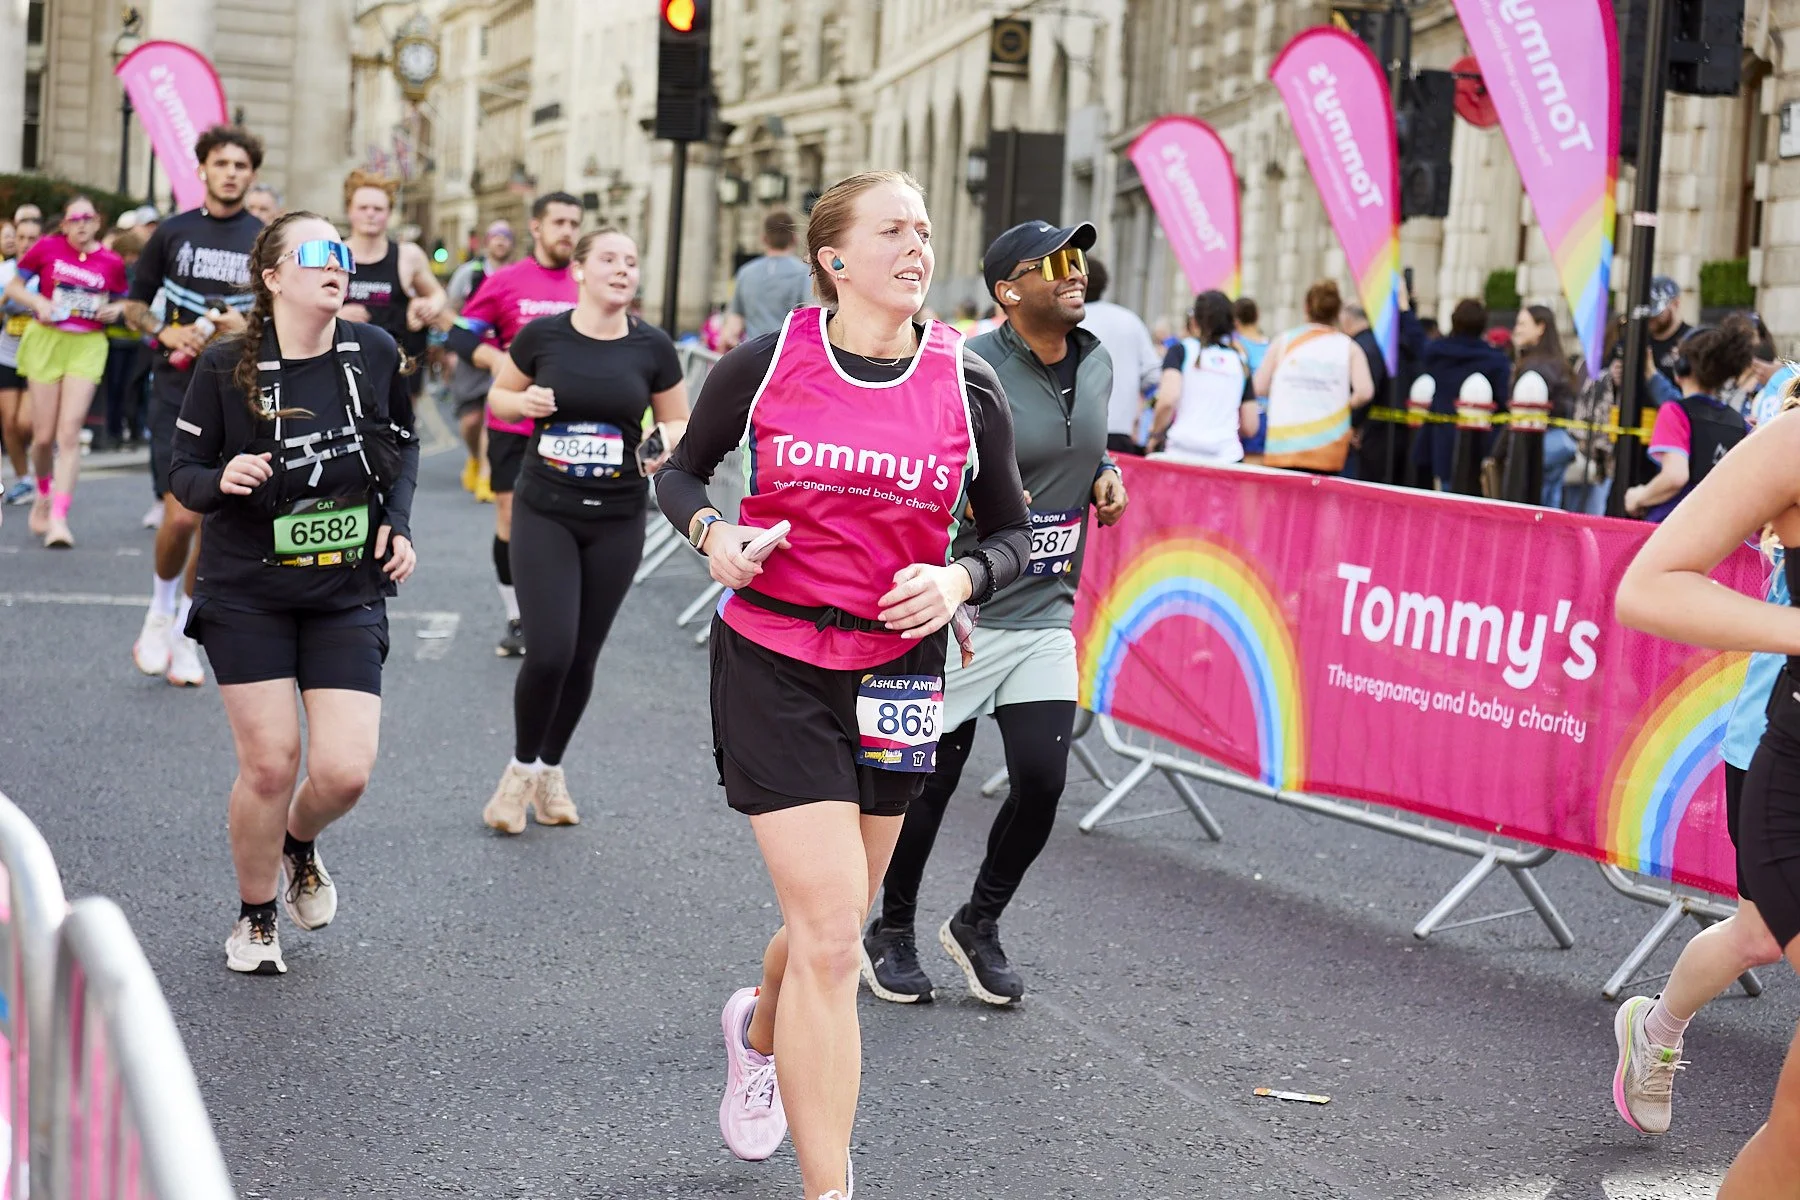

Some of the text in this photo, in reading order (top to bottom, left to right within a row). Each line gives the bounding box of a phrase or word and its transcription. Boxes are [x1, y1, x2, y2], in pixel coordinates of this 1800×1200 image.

[53, 258, 106, 289] Tommy's
[552, 439, 608, 459] 9844
[772, 434, 950, 491] Tommy's
[316, 501, 335, 511] CAT
[847, 485, 871, 497] and
[872, 488, 904, 506] baby
[905, 497, 942, 513] charity
[290, 514, 359, 547] 6582
[1059, 513, 1067, 522] A
[1337, 562, 1600, 689] Tommy's
[869, 679, 911, 690] ASHLEY
[1327, 663, 1588, 744] The pregnancy and baby charity
